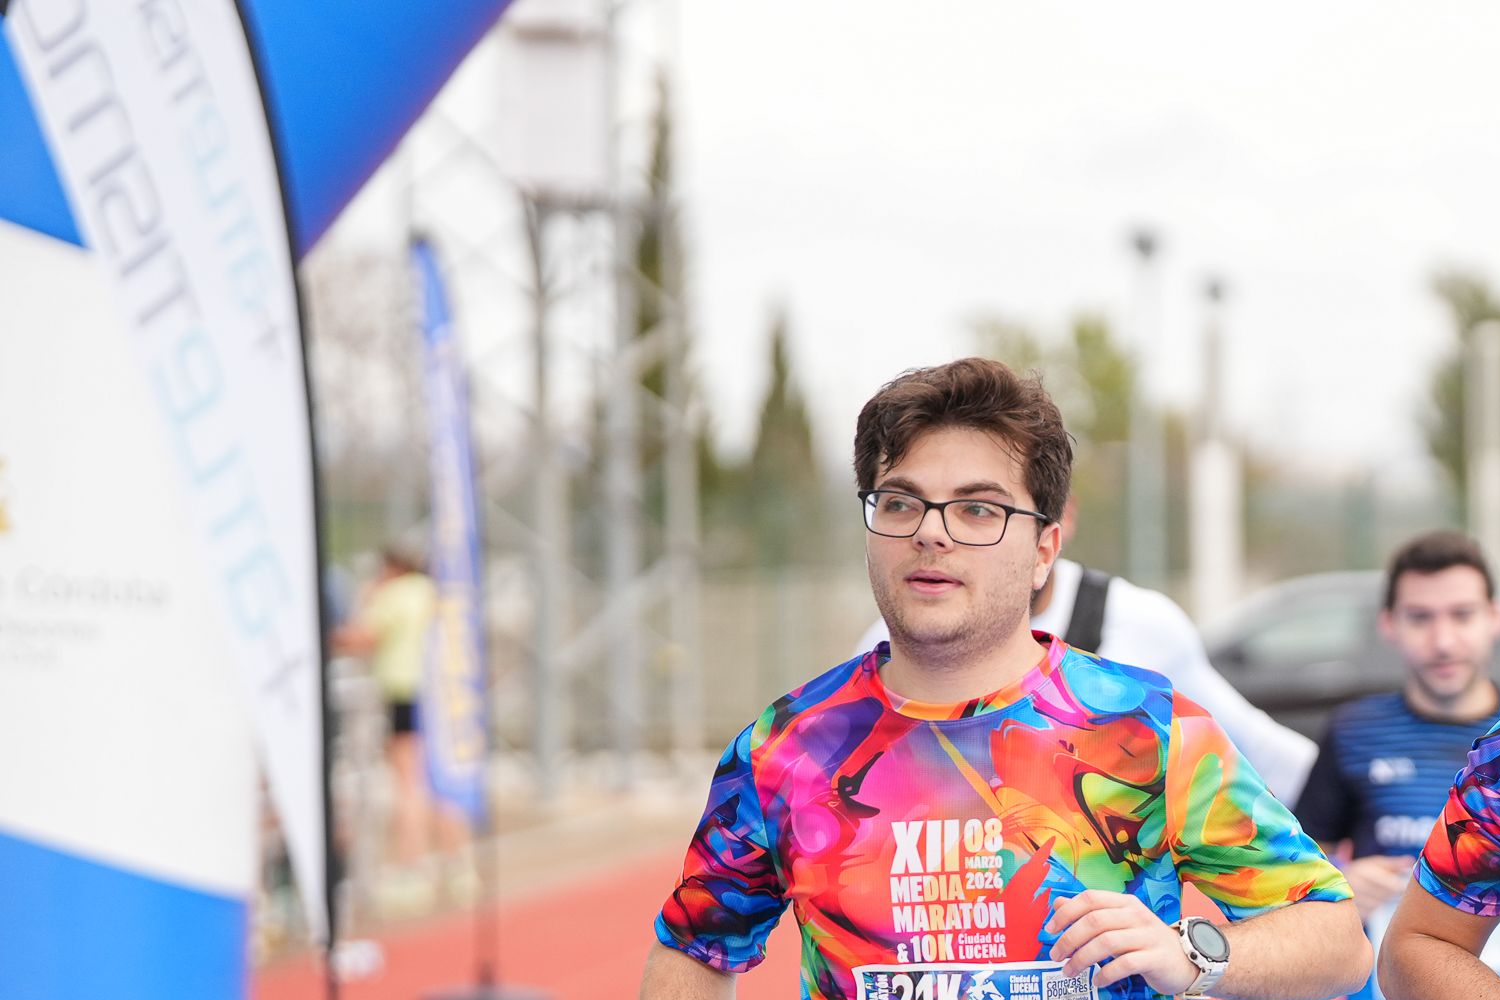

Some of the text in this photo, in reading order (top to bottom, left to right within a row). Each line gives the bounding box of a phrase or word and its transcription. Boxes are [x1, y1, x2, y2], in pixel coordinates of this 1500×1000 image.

[890, 819, 960, 874] XII
[963, 818, 1003, 852] 08
[964, 855, 1003, 869] MARZO
[890, 874, 965, 903] MEDIA
[965, 872, 1004, 890] 2026
[892, 896, 1006, 933] MARATÓN
[897, 933, 955, 963] & 10K
[958, 932, 1006, 944] Ciudad de
[958, 943, 1007, 960] LUCENA
[1046, 977, 1081, 989] carreras
